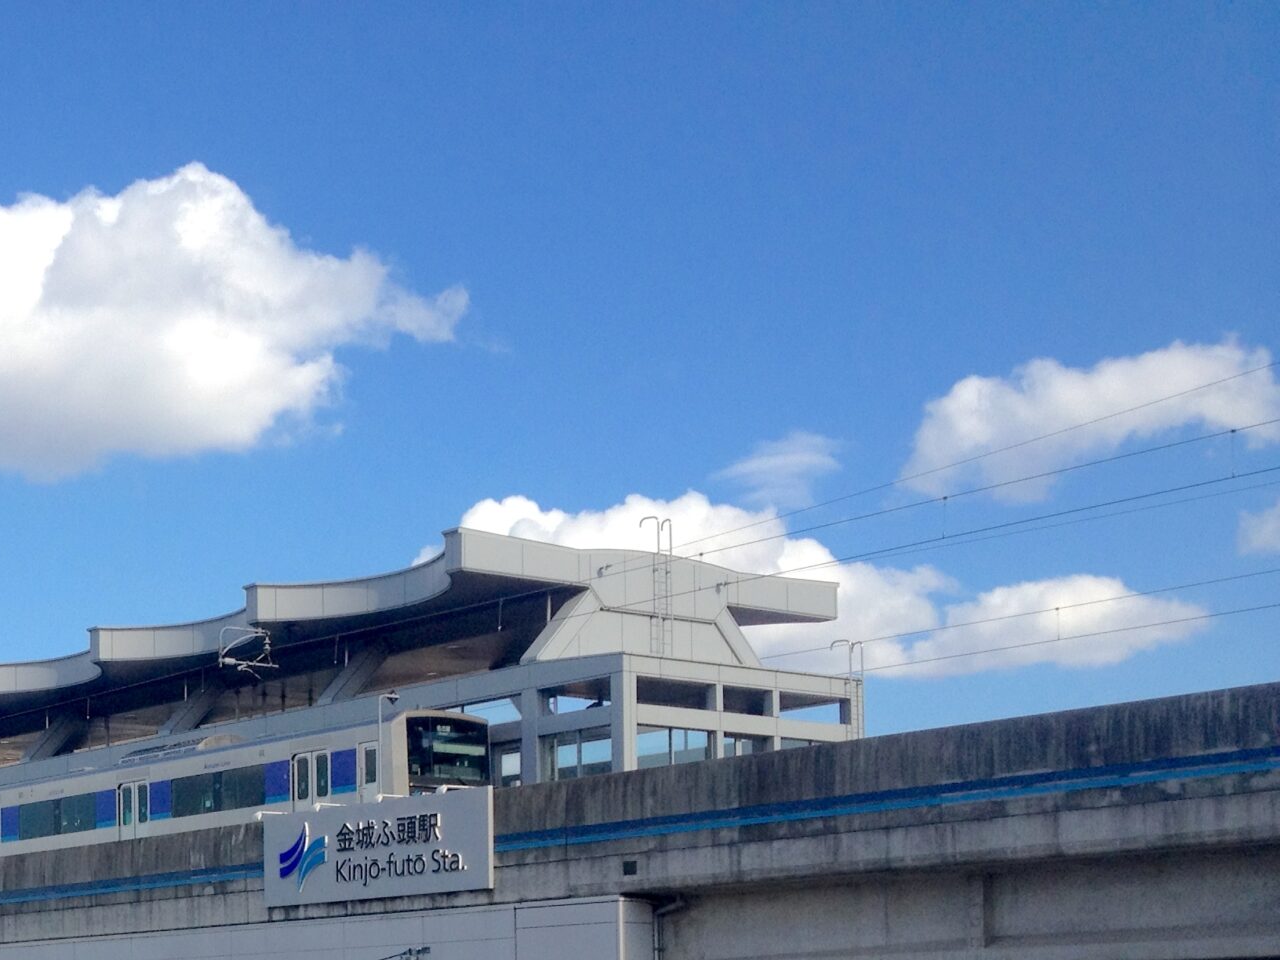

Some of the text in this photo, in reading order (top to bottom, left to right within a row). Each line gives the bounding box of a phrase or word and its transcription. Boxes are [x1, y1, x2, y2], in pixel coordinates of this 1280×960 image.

[336, 813, 441, 852] 金城ふ頭駅
[431, 849, 468, 873] Sta.
